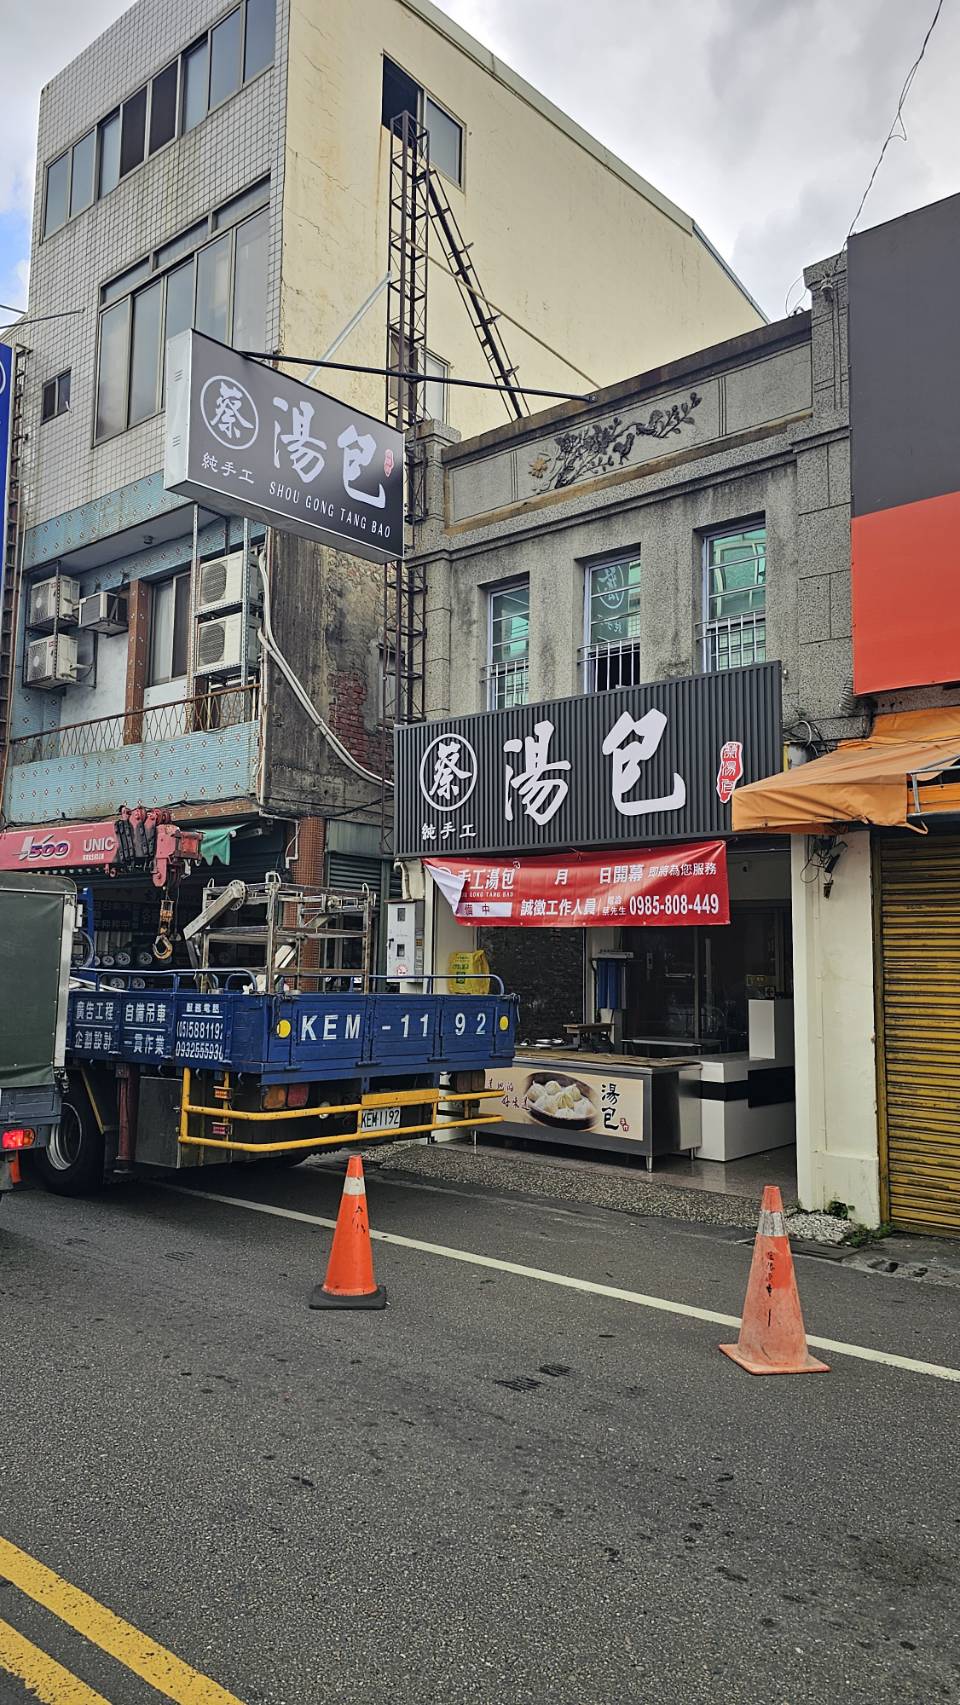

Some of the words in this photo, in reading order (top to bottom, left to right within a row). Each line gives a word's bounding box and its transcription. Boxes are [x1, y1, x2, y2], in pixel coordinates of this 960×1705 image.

[211, 381, 254, 439] 蔡
[273, 397, 386, 509] 湯包
[201, 452, 254, 484] 純手工
[269, 481, 299, 504] SHOU
[305, 495, 333, 517] GONG
[340, 507, 367, 530] TANG
[371, 520, 391, 538] BAO
[428, 741, 472, 800] 蔡
[503, 708, 686, 826] 湯包
[421, 821, 477, 840] 純手工
[83, 838, 114, 852] UNIC
[554, 868, 569, 885] 月
[599, 864, 644, 884] 日開幕
[520, 898, 596, 916] 誠徵工作人員
[629, 893, 719, 916] 0985-808-449
[76, 1001, 114, 1020] 廣告工程
[125, 1002, 166, 1023] 自備吊車
[75, 1030, 113, 1051] 企劃設計
[124, 1033, 165, 1055] 一貫作業
[601, 1082, 620, 1131] 湯包
